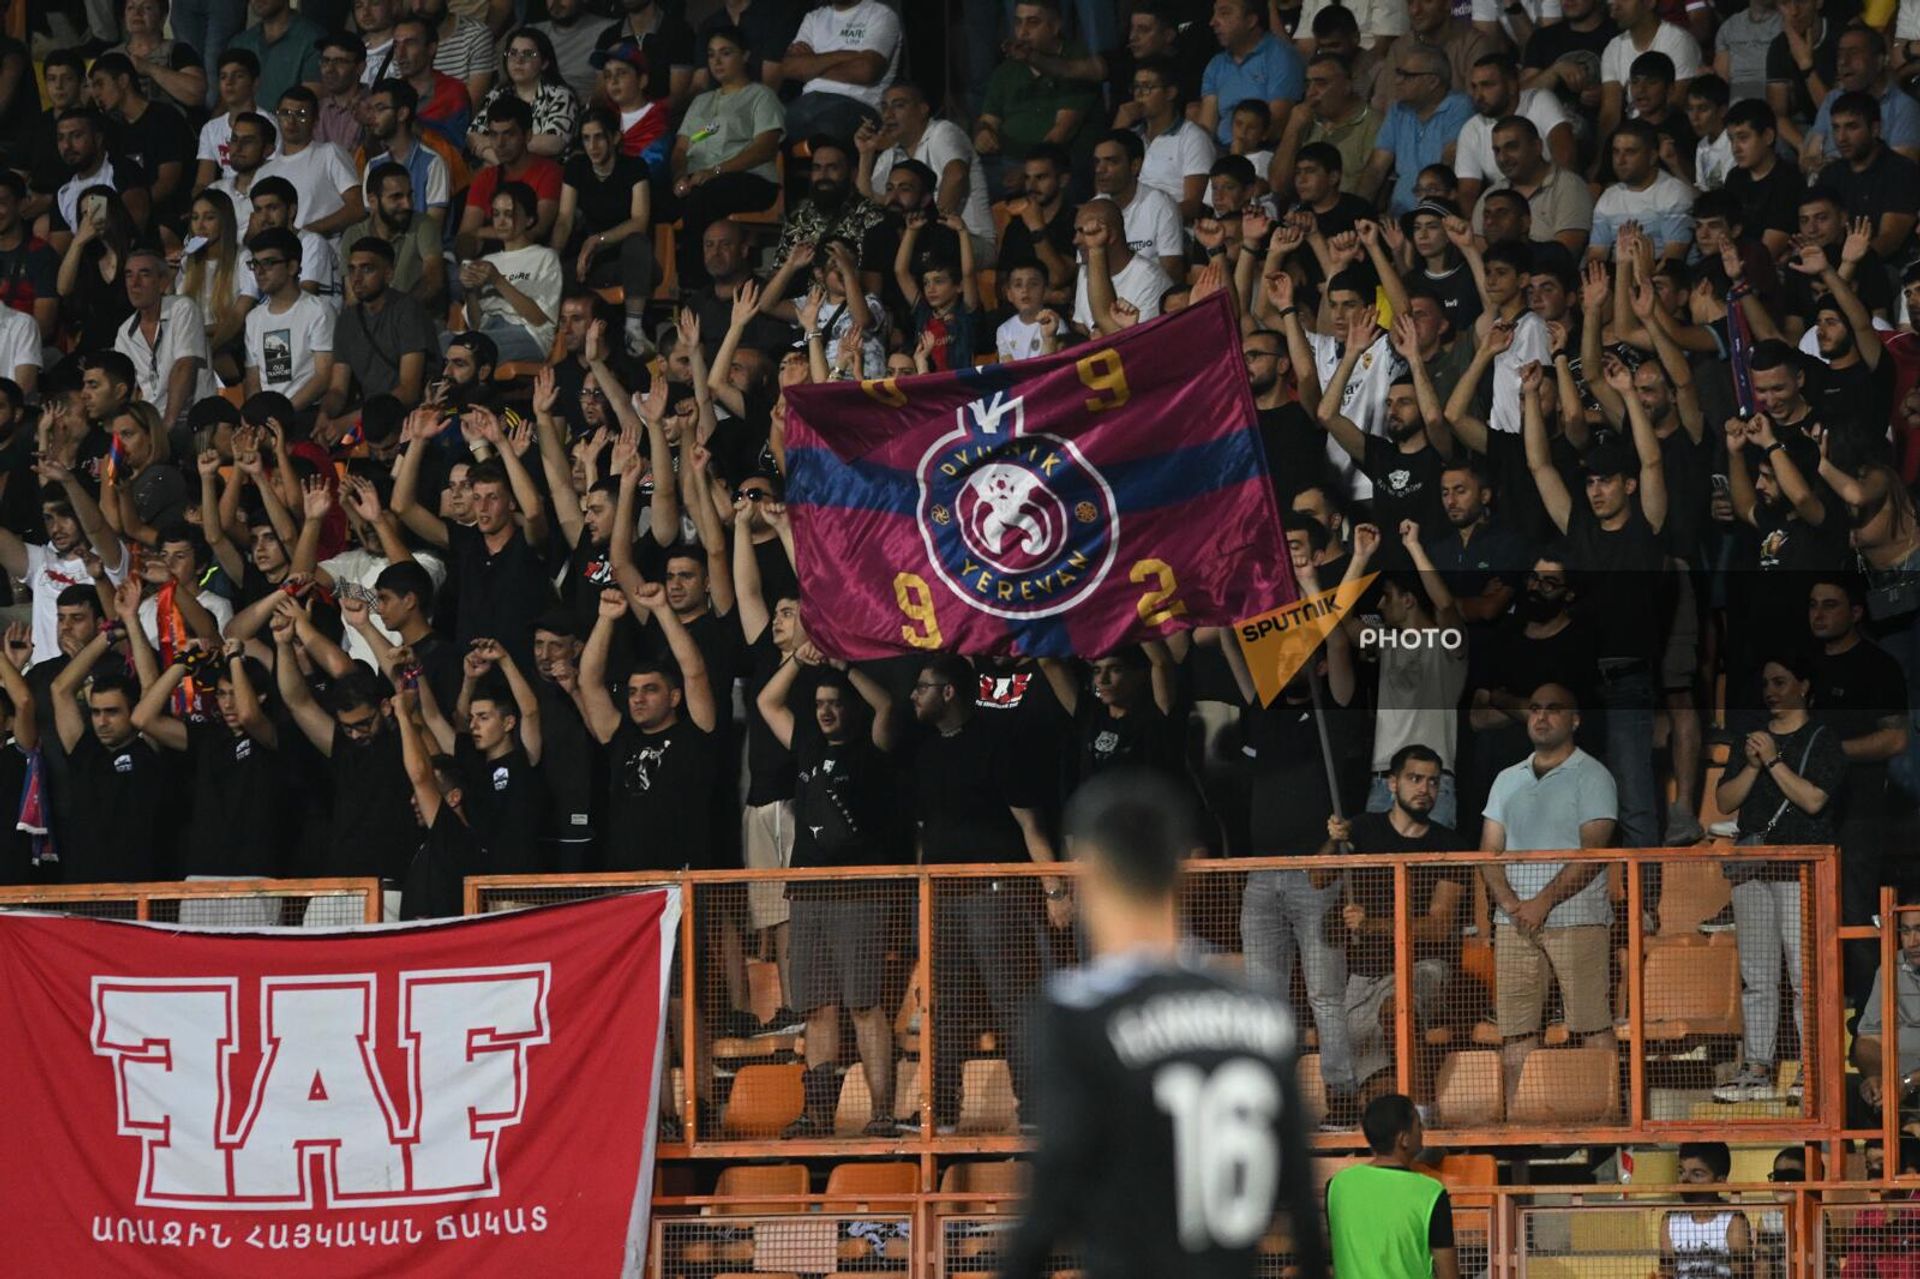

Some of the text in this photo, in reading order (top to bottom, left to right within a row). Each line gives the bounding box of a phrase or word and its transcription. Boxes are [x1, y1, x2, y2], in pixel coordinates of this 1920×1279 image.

[1076, 348, 1131, 411] 9
[893, 558, 1191, 650] 9 2
[960, 550, 1090, 602] YEREVAN
[1154, 1056, 1281, 1252] 16
[91, 1216, 231, 1248] ԱՌԱՋԻՆ
[245, 1218, 422, 1250] ՀԱՅԿԱԿԱՆ
